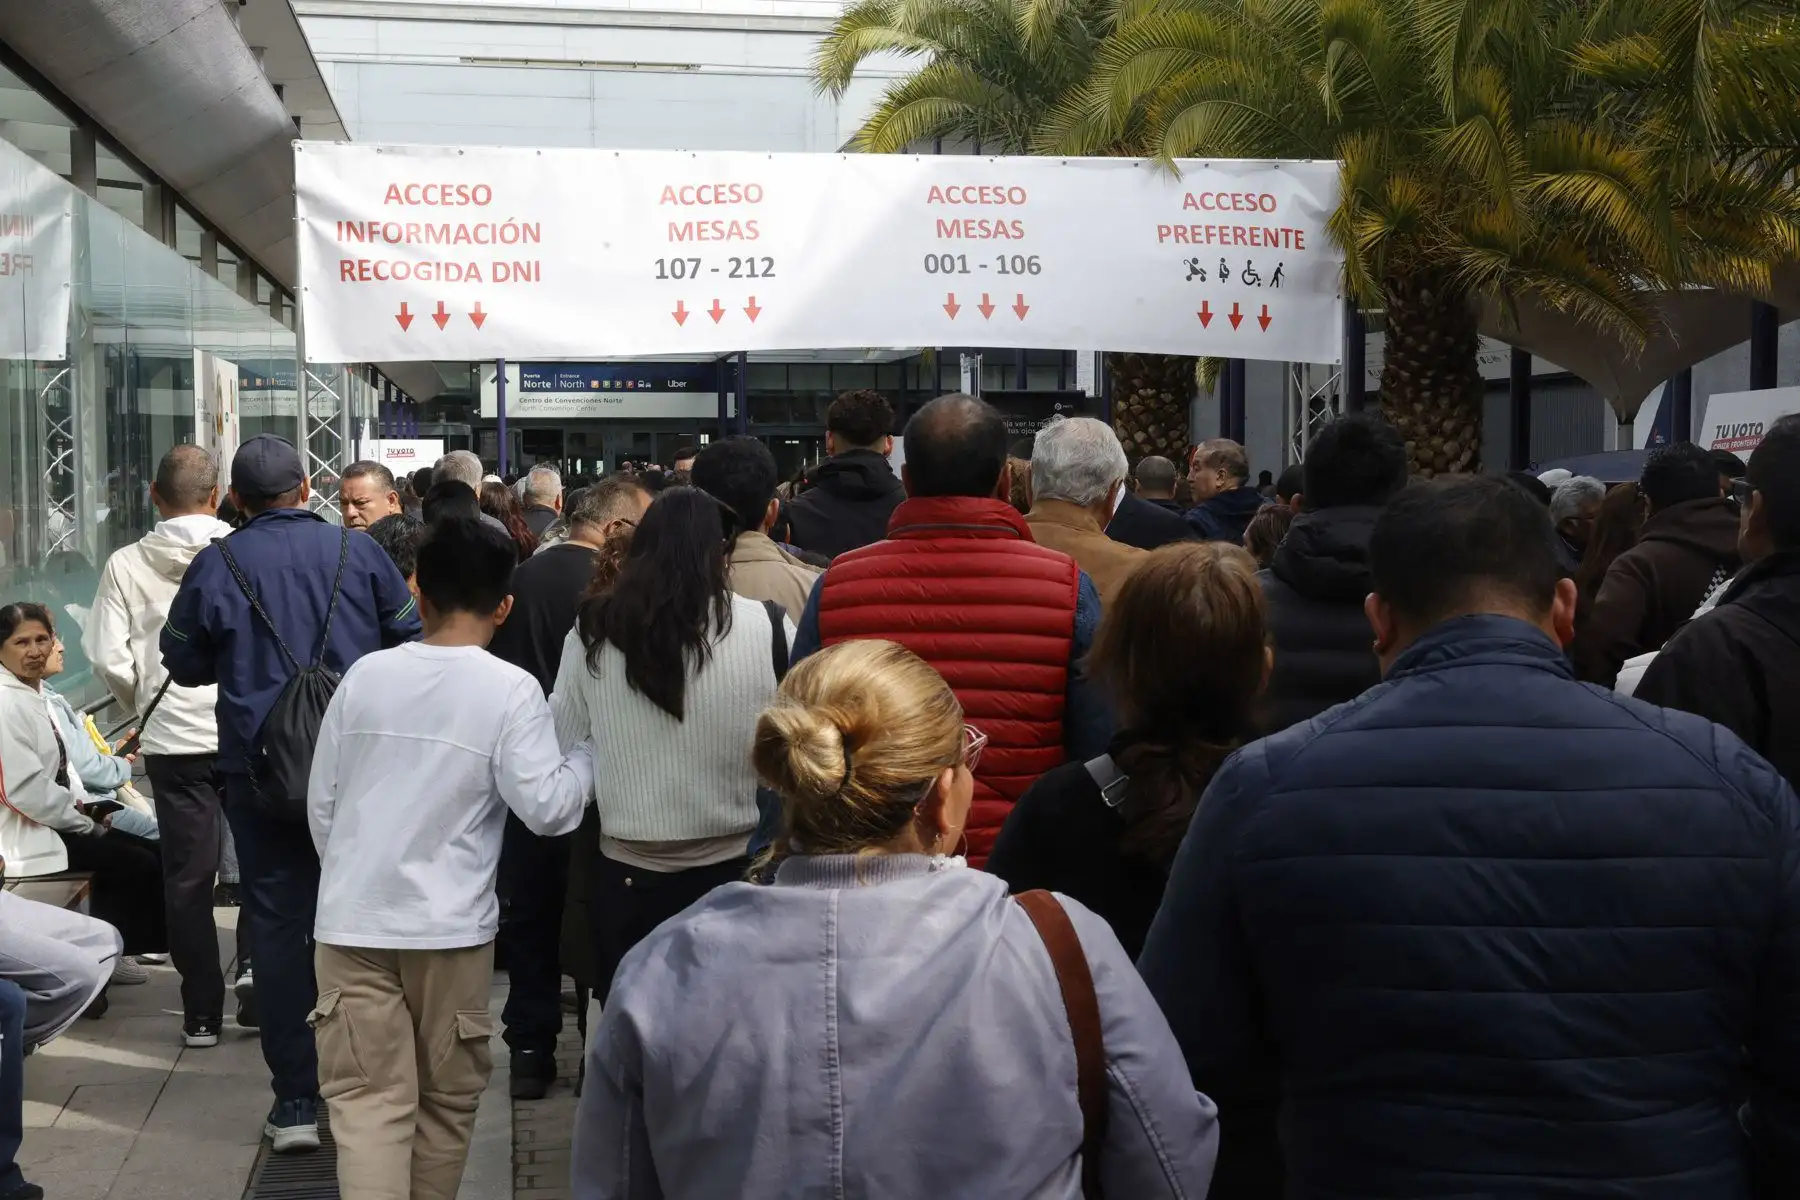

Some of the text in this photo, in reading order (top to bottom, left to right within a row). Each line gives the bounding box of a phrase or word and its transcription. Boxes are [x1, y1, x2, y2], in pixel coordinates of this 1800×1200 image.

[384, 183, 492, 206] ACCESO
[660, 183, 763, 206] ACCESO
[927, 185, 1027, 206] ACCESO
[1182, 191, 1277, 213] ACCESO
[336, 217, 541, 245] INFORMACIÓN
[668, 219, 760, 242] MESAS
[936, 218, 1024, 240] MESAS
[1157, 224, 1306, 251] PREFERENTE
[339, 259, 541, 284] RECOGIDA DNI
[655, 257, 701, 280] 107
[728, 256, 776, 279] 212
[923, 253, 971, 275] 001
[996, 254, 1042, 276] 106
[524, 380, 552, 389] Norte
[560, 380, 585, 389] North
[667, 380, 687, 388] Uber
[544, 396, 553, 404] de
[1715, 422, 1764, 439] TU VOTO
